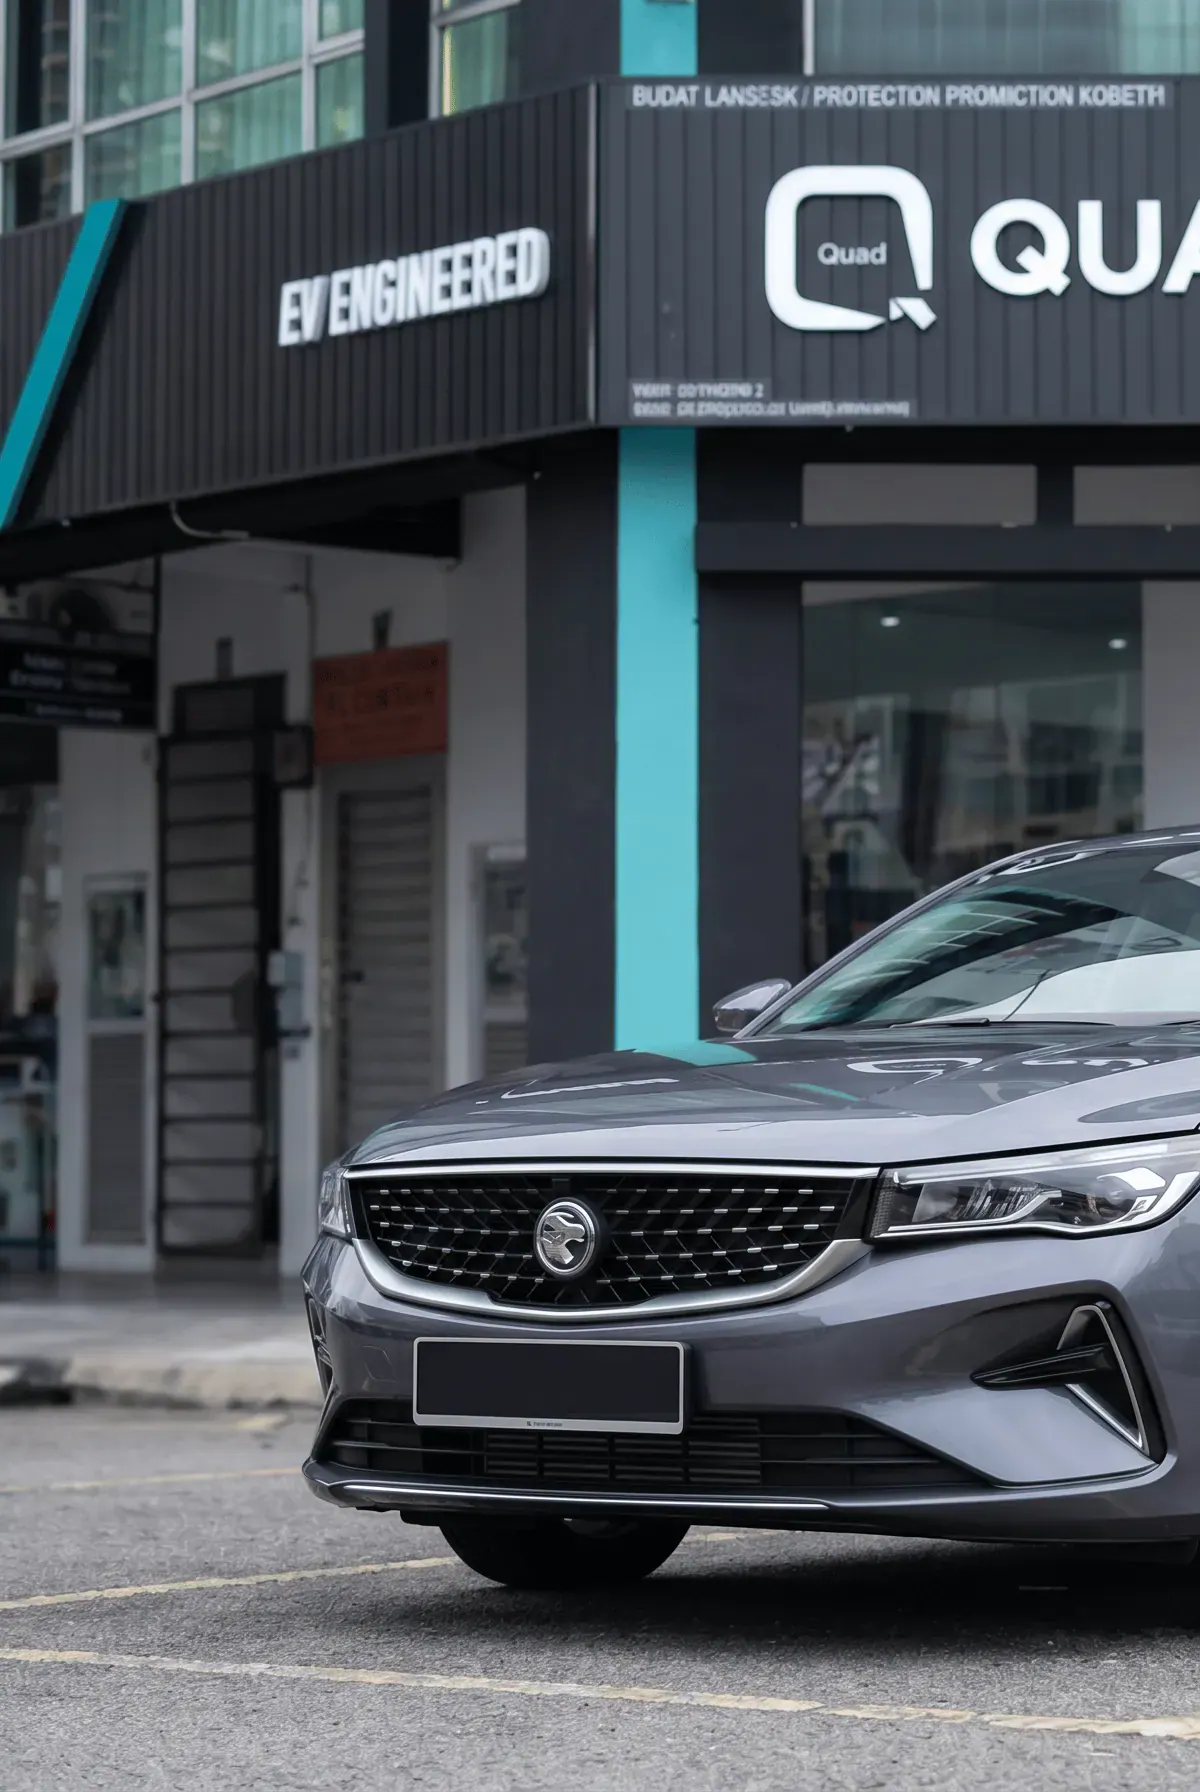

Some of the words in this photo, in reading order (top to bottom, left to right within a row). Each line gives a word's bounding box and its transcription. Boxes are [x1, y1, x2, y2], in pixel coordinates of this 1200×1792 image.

[813, 84, 940, 107] PROTECTION
[817, 241, 887, 265] Quad
[278, 275, 330, 347] EV
[328, 227, 550, 337] ENGINEERED
